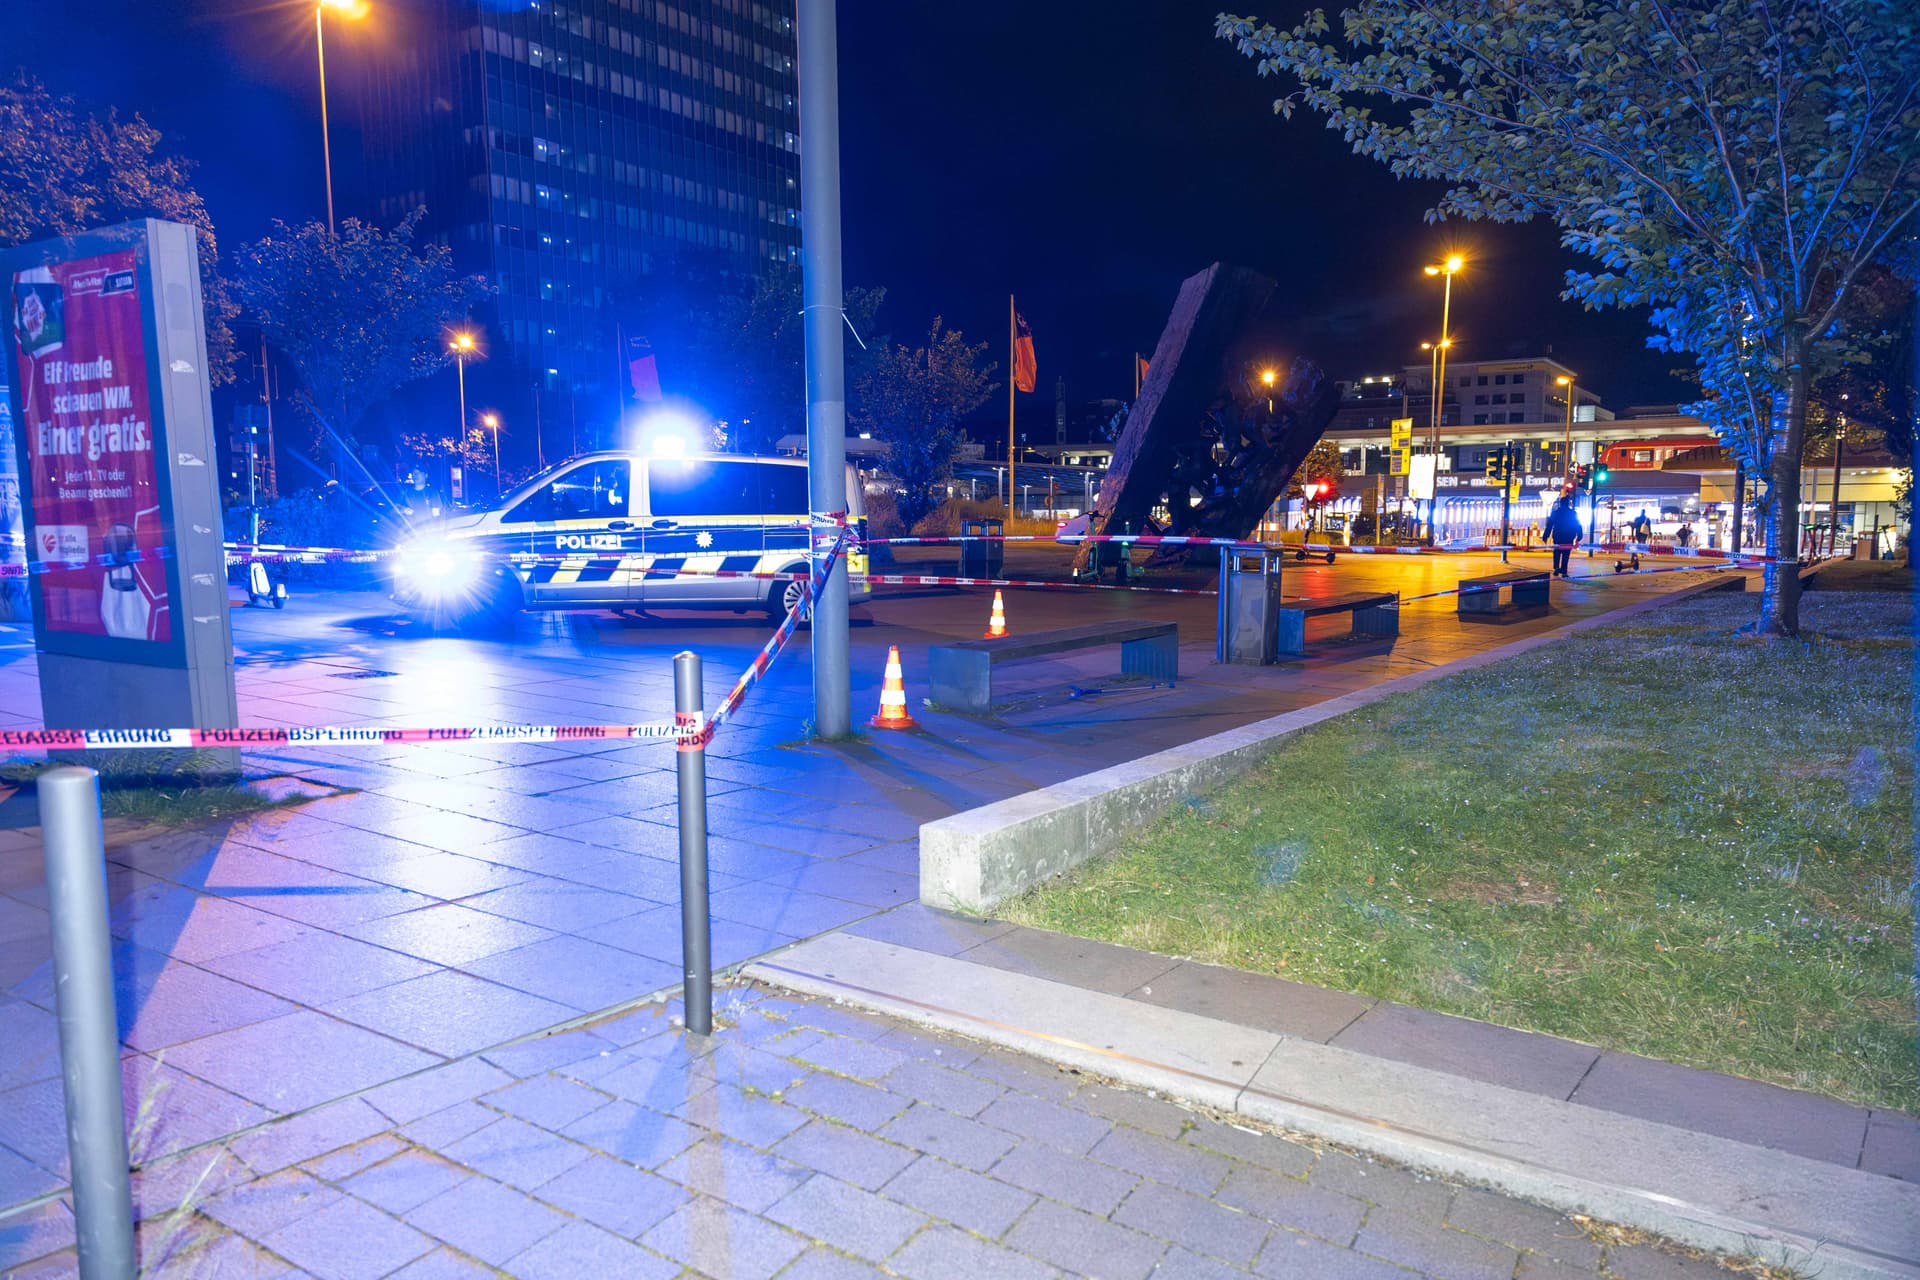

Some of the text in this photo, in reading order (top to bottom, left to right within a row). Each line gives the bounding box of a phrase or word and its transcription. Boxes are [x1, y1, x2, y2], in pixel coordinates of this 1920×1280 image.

[54, 386, 133, 414] schauen WM.
[38, 421, 84, 456] Einer
[88, 415, 151, 461] gratis.
[108, 468, 126, 481] oder
[555, 534, 622, 550] POLIZEI
[0, 730, 172, 745] EIABSPERRUNG
